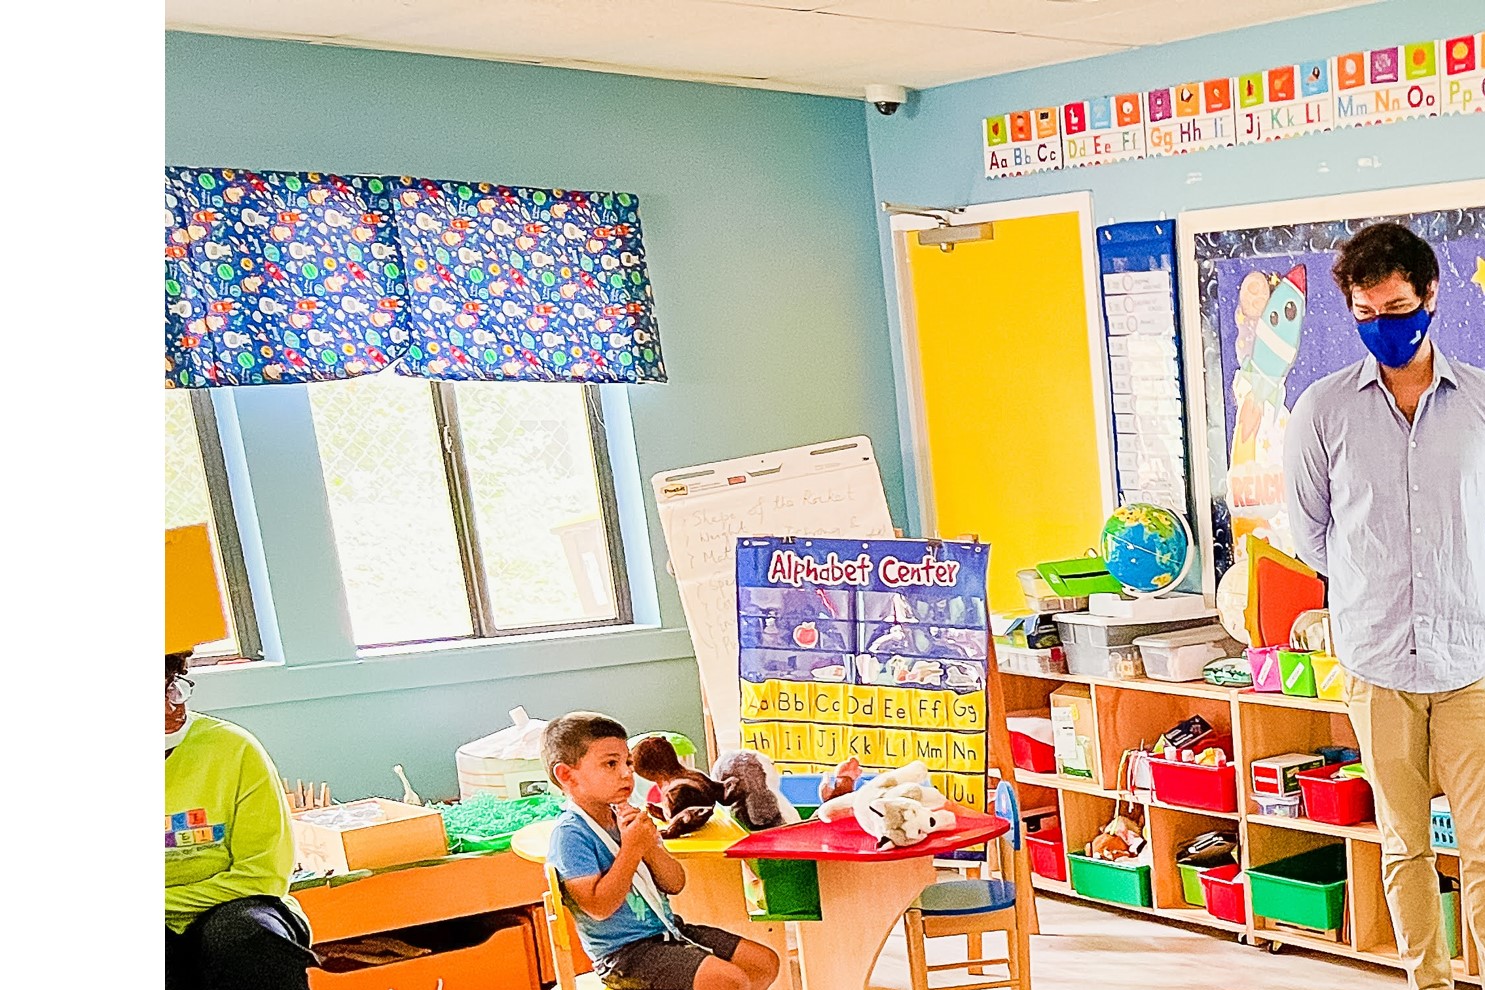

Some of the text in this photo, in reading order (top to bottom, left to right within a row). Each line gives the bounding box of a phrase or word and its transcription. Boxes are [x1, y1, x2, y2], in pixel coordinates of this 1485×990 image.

[990, 152, 1008, 170] Aa
[1014, 147, 1031, 166] Bb
[1037, 143, 1056, 162] Cc
[1068, 139, 1086, 158] Dd
[1094, 135, 1111, 154] Ee
[1122, 132, 1138, 150] Ff
[1151, 128, 1173, 153] Gg
[1180, 119, 1201, 143] Hh
[1245, 113, 1261, 140] Jj
[1271, 107, 1295, 130] Kk
[1338, 95, 1367, 118] Mm
[1375, 89, 1400, 112] Nn
[1407, 85, 1435, 108] Oo
[1449, 80, 1472, 111] Pp
[771, 553, 957, 585] Alphabet Center
[778, 692, 804, 711] Bb
[815, 694, 840, 712] Cc
[848, 695, 873, 715] Dd
[884, 698, 906, 719] Ee
[919, 699, 941, 718] Ff
[953, 698, 977, 723] Gg
[785, 731, 801, 750] Ii
[817, 730, 836, 757] Jj
[850, 736, 871, 755] Kk
[917, 740, 942, 758] Mm
[953, 741, 977, 760] Nn
[954, 784, 975, 804] Uu
